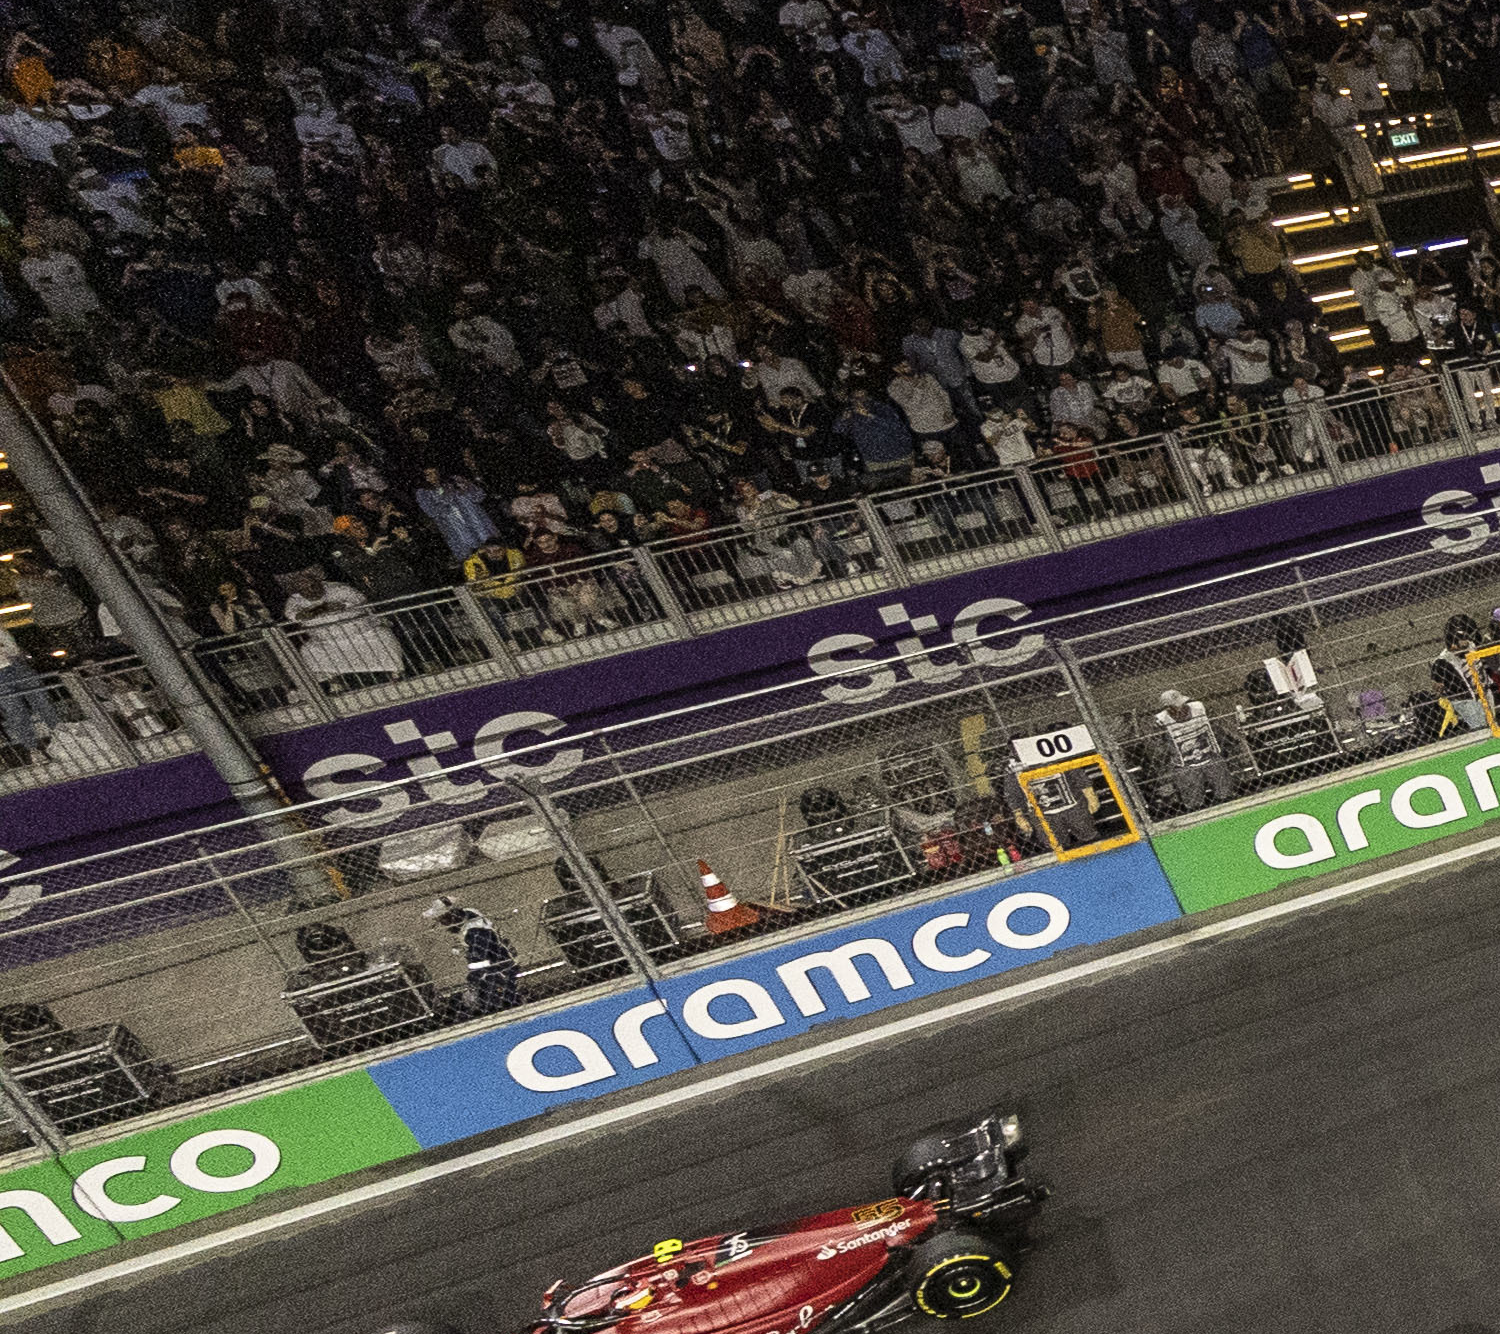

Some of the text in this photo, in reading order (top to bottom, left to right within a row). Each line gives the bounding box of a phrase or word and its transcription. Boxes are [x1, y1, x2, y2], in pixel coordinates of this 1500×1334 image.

[1392, 134, 1417, 146] EXIT
[806, 597, 1046, 705] stc
[302, 710, 585, 829] stc
[1035, 733, 1073, 759] 00
[505, 866, 1071, 1093] aramco
[837, 1218, 911, 1255] Santander
